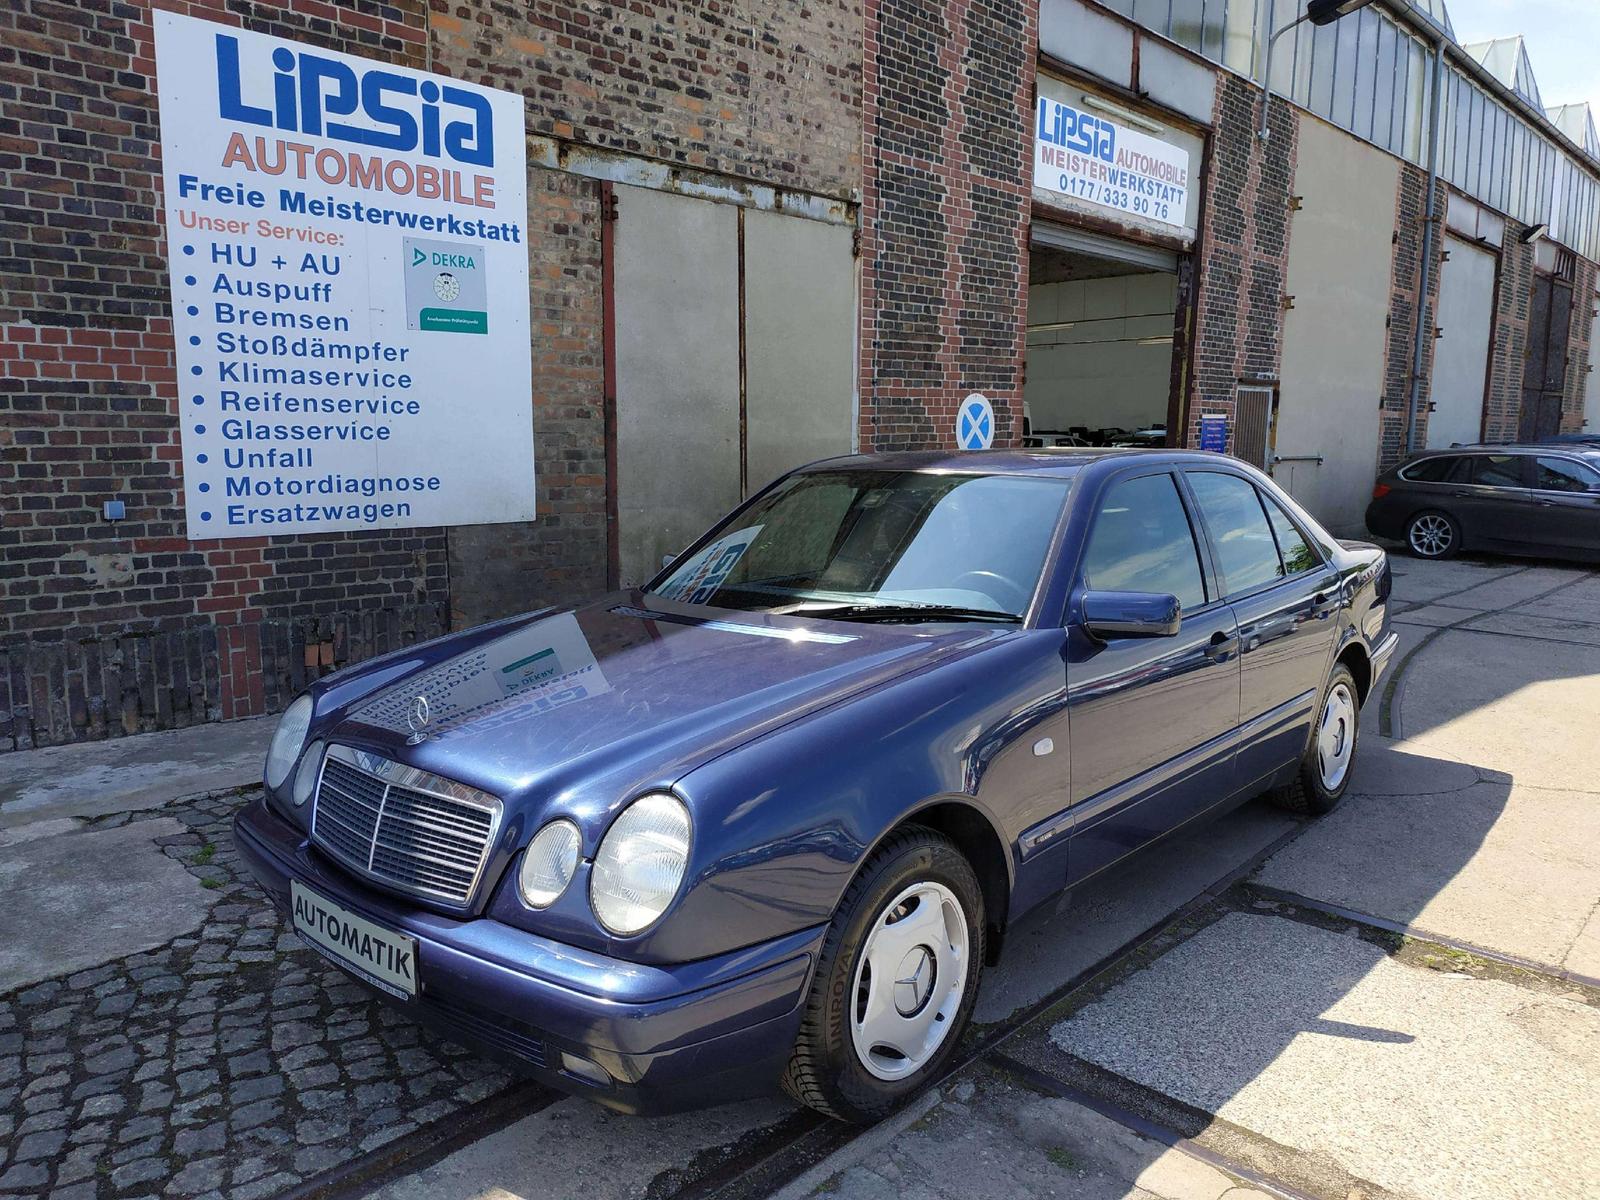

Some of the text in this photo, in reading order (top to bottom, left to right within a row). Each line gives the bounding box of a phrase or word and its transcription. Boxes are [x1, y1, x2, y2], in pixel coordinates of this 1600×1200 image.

[221, 132, 496, 209] AUTOMOBILE
[1116, 147, 1186, 186] AUTOMOBILE
[178, 174, 521, 243] Freie Meisterwerkstatt
[1133, 196, 1149, 214] 90
[1154, 202, 1168, 219] 76
[178, 210, 345, 247] Unser Service:
[211, 242, 256, 267] HU
[300, 253, 341, 276] AU
[432, 251, 476, 270] DEKRA
[212, 273, 333, 304] Auspuff
[214, 302, 350, 332] Bremsen
[216, 332, 410, 363] Stoßdämpfer
[218, 361, 412, 389] Klimaservice
[220, 390, 421, 416] Reifenservice
[221, 419, 391, 441] Glasservice
[223, 448, 313, 469] Unfall
[225, 474, 441, 498] Motordiagnose
[227, 501, 411, 525] Ersatzwagen
[295, 894, 412, 980] AUTOMATIK
